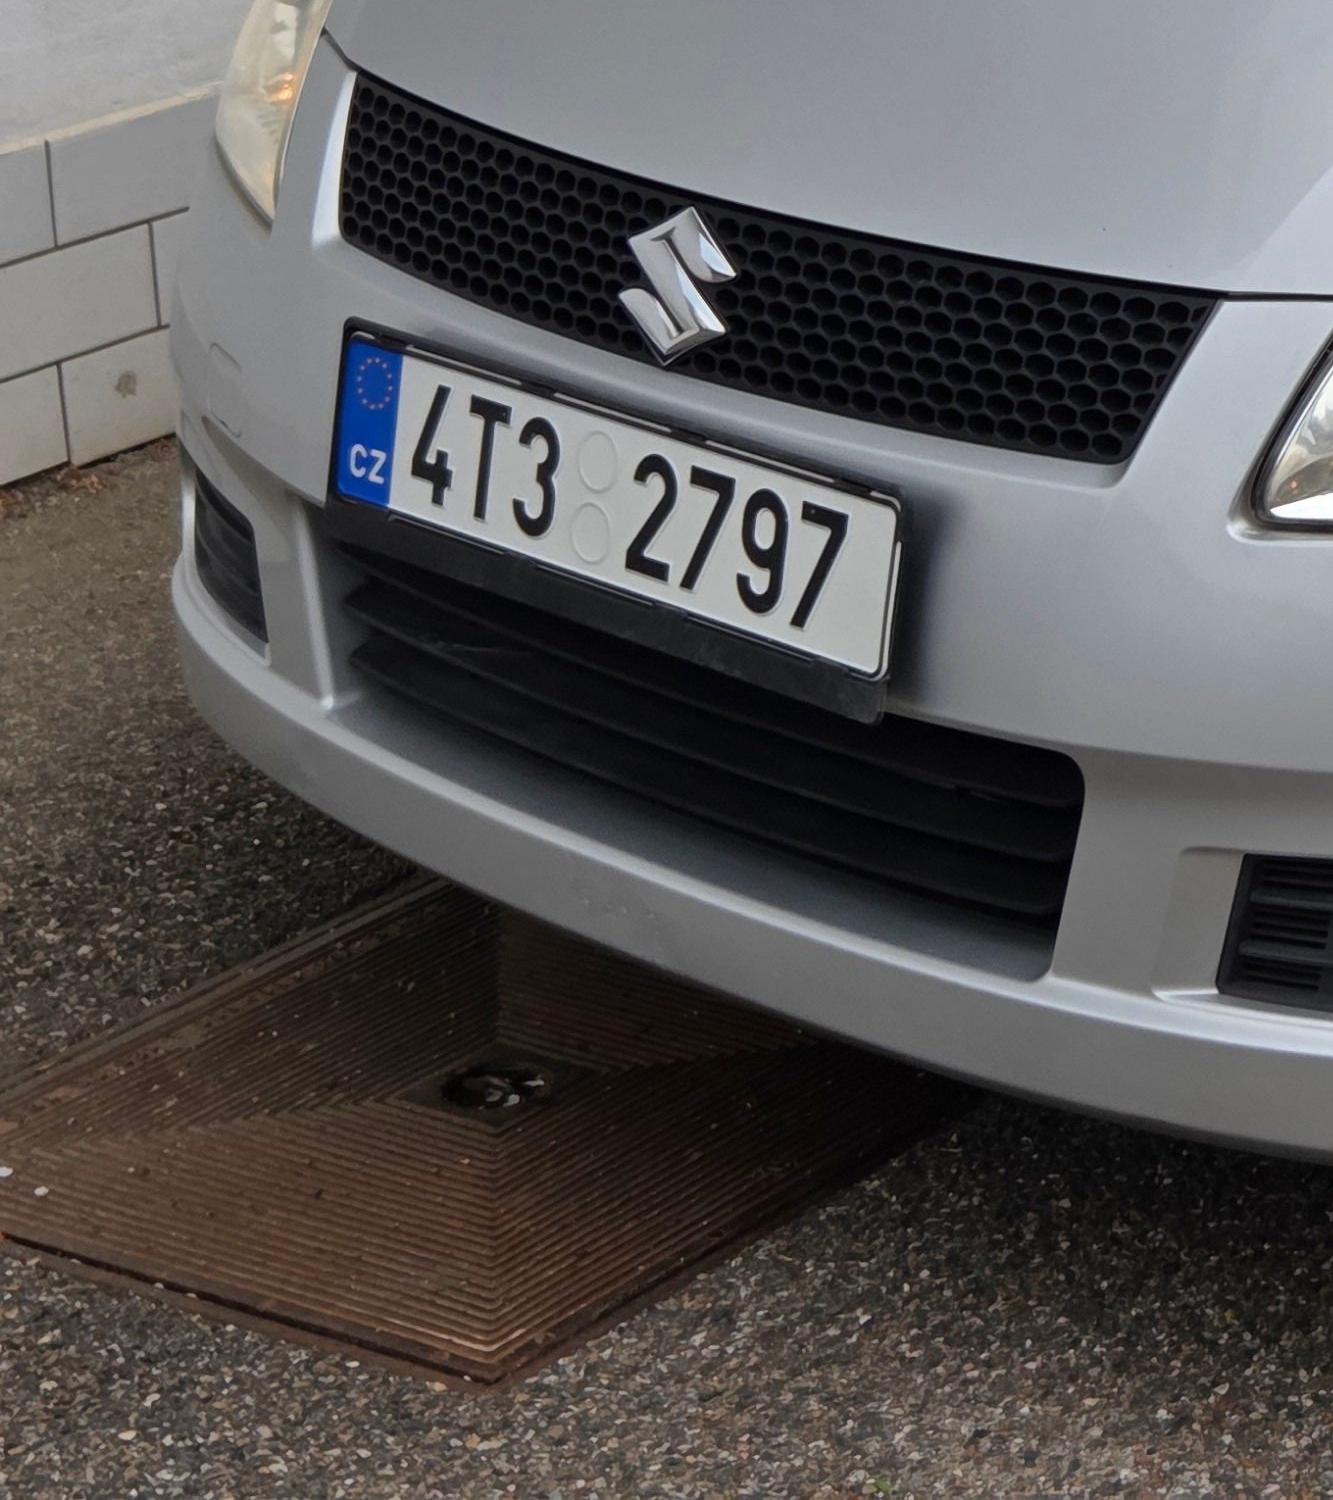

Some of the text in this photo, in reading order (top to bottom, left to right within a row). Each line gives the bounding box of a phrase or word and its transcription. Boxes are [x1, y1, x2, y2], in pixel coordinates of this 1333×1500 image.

[349, 443, 386, 486] CZ
[410, 384, 850, 630] 4T3 2797
